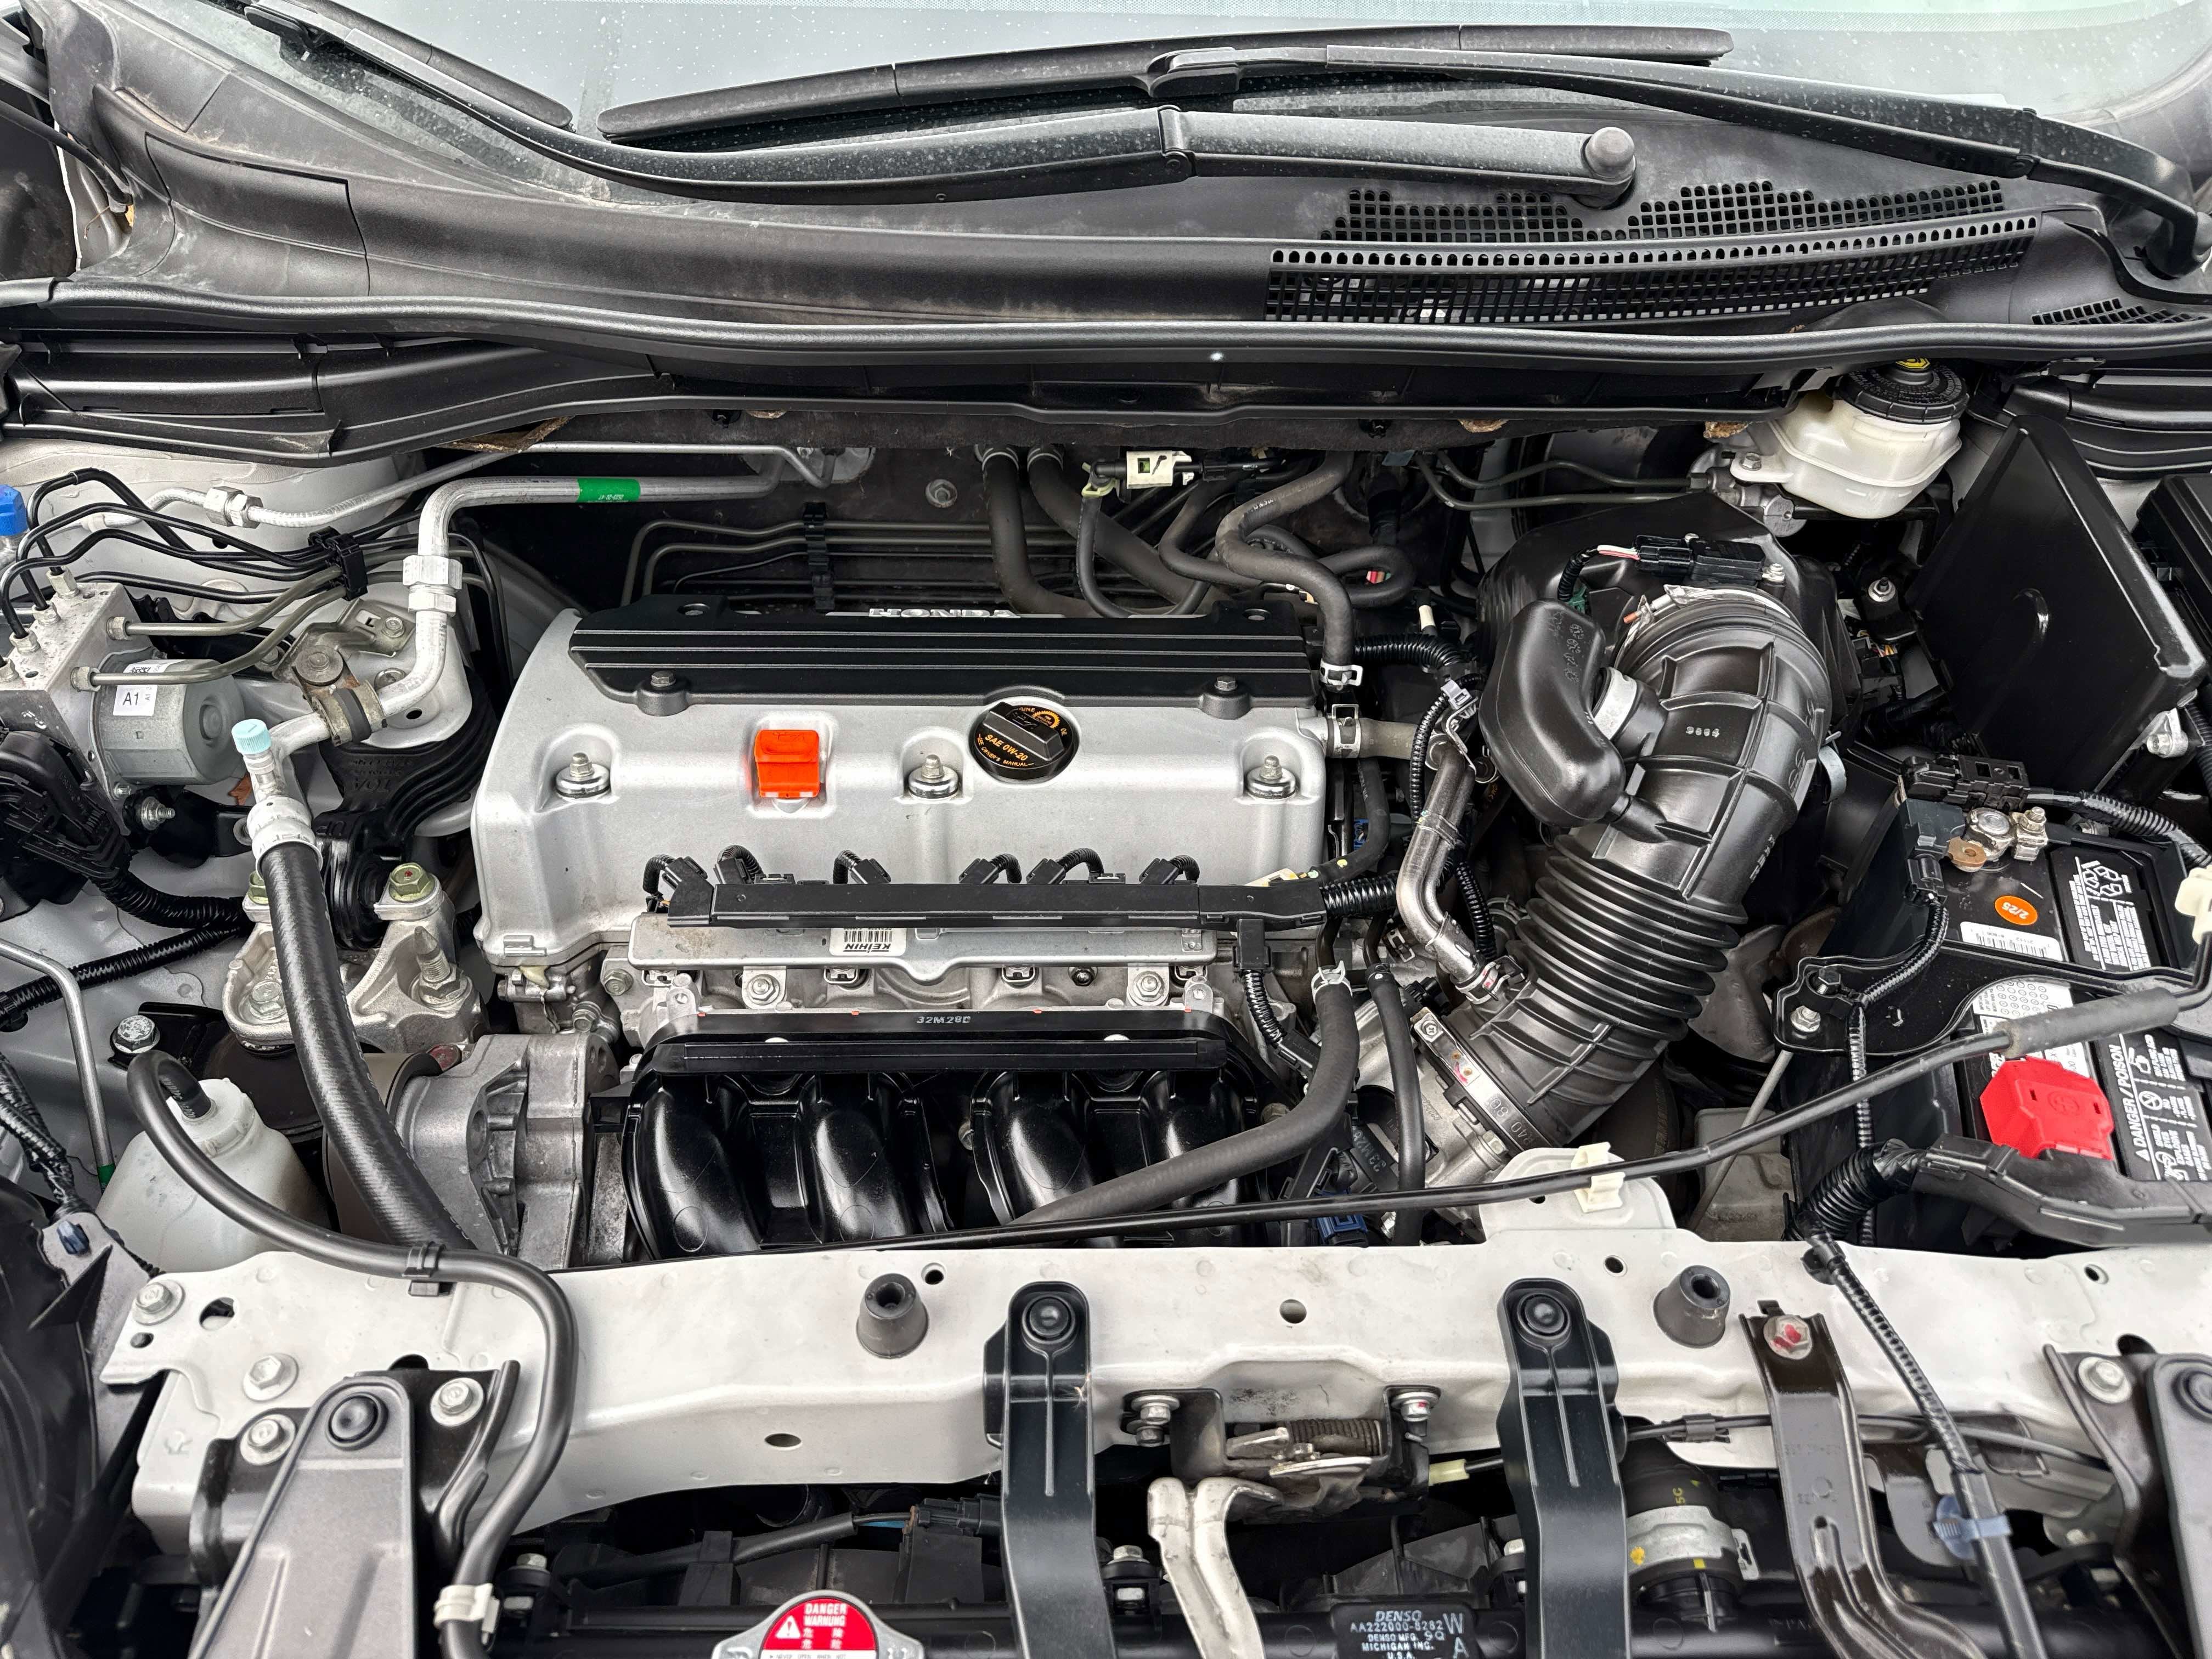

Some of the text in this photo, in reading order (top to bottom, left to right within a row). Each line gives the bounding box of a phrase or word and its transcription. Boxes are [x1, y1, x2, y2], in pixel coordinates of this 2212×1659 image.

[869, 608, 1021, 618] HONDA
[122, 692, 139, 706] A1
[985, 734, 1028, 761] SAE 0W-20
[981, 747, 1001, 761] OWNER'S
[2001, 901, 2029, 919] 2/25
[845, 943, 891, 952] KEIHIN
[804, 1603, 848, 1615] DANGER
[804, 1615, 845, 1627] WARNUNG
[1375, 1610, 1422, 1622] DENSO
[1350, 1620, 1444, 1633] AA222000-8282
[1442, 1613, 1463, 1634] W
[1368, 1633, 1396, 1642] DENSO
[1361, 1642, 1410, 1652] MICHIGAN
[1453, 1637, 1469, 1659] A
